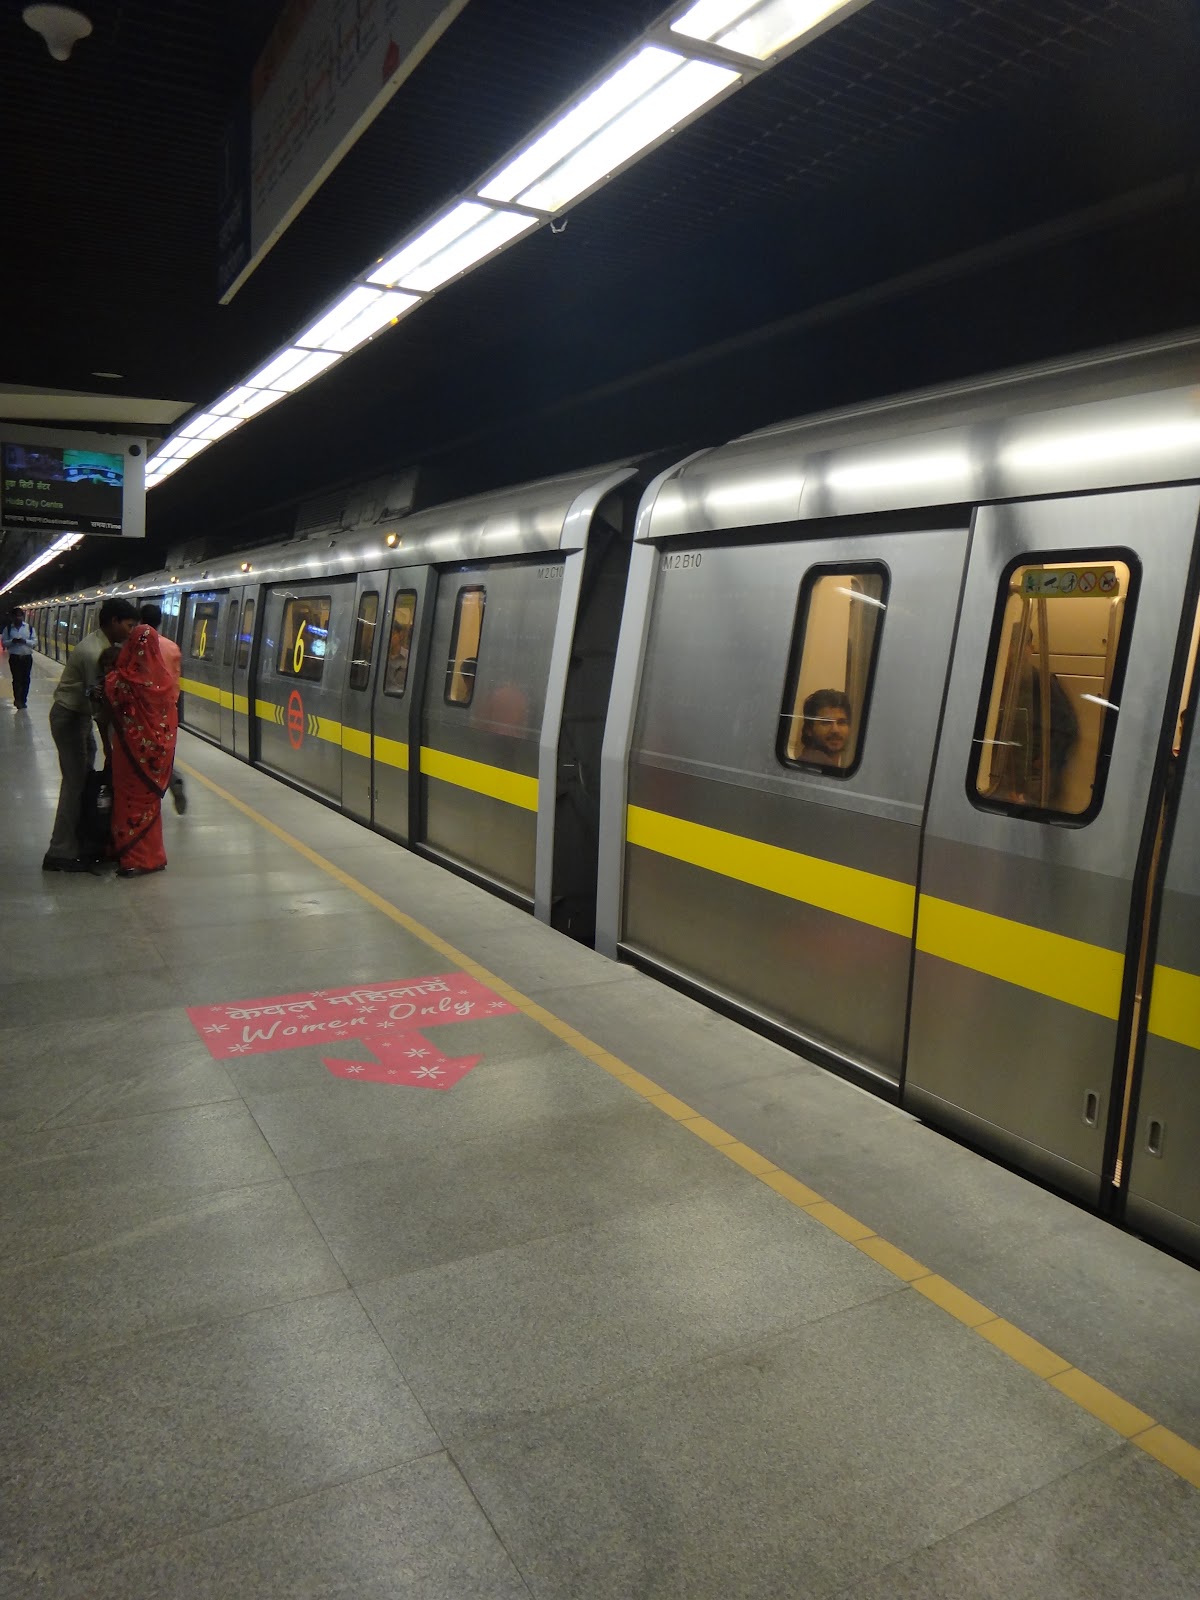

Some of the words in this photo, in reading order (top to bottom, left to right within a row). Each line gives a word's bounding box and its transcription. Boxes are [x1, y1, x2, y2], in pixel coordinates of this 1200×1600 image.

[25, 498, 39, 508] City
[40, 499, 64, 509] Centre
[199, 619, 208, 657] 6
[293, 619, 306, 673] 6
[225, 1000, 318, 1020] केवल
[242, 1016, 368, 1042] Women
[389, 996, 476, 1020] Only
